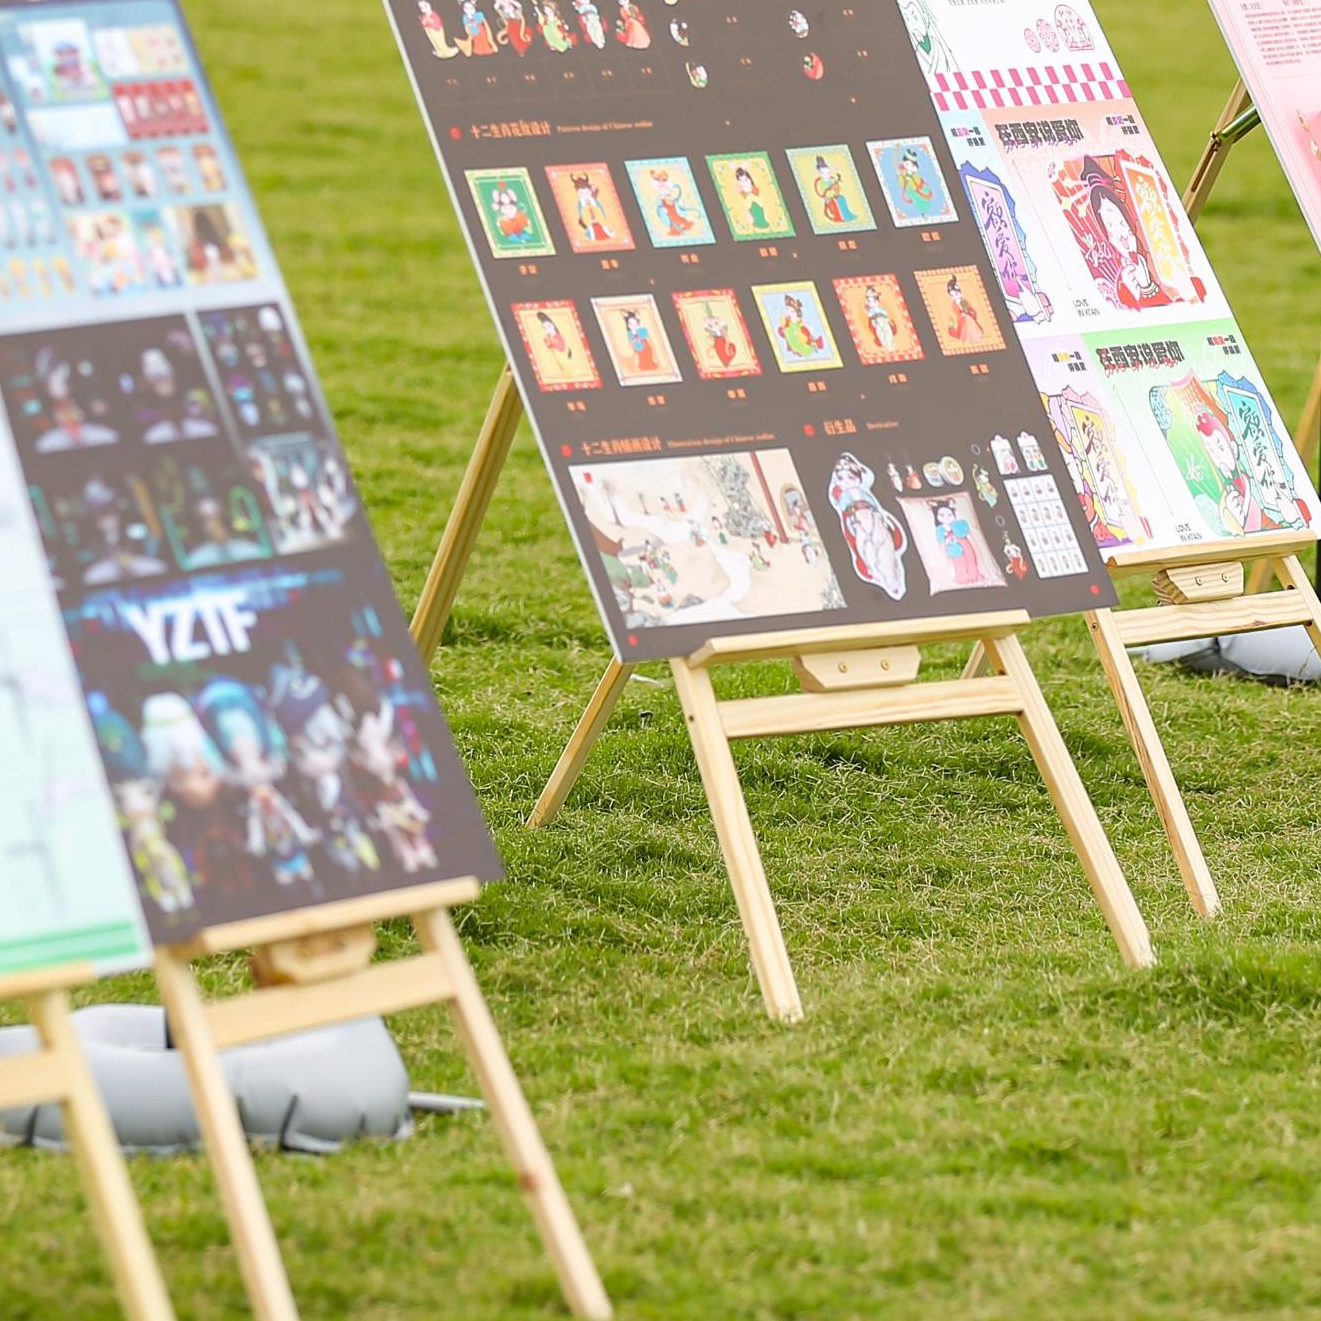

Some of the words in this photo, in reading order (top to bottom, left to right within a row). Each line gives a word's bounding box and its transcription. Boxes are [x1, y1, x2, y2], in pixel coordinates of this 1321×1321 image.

[823, 419, 857, 435] 衍生品
[124, 589, 259, 666] YZTF
